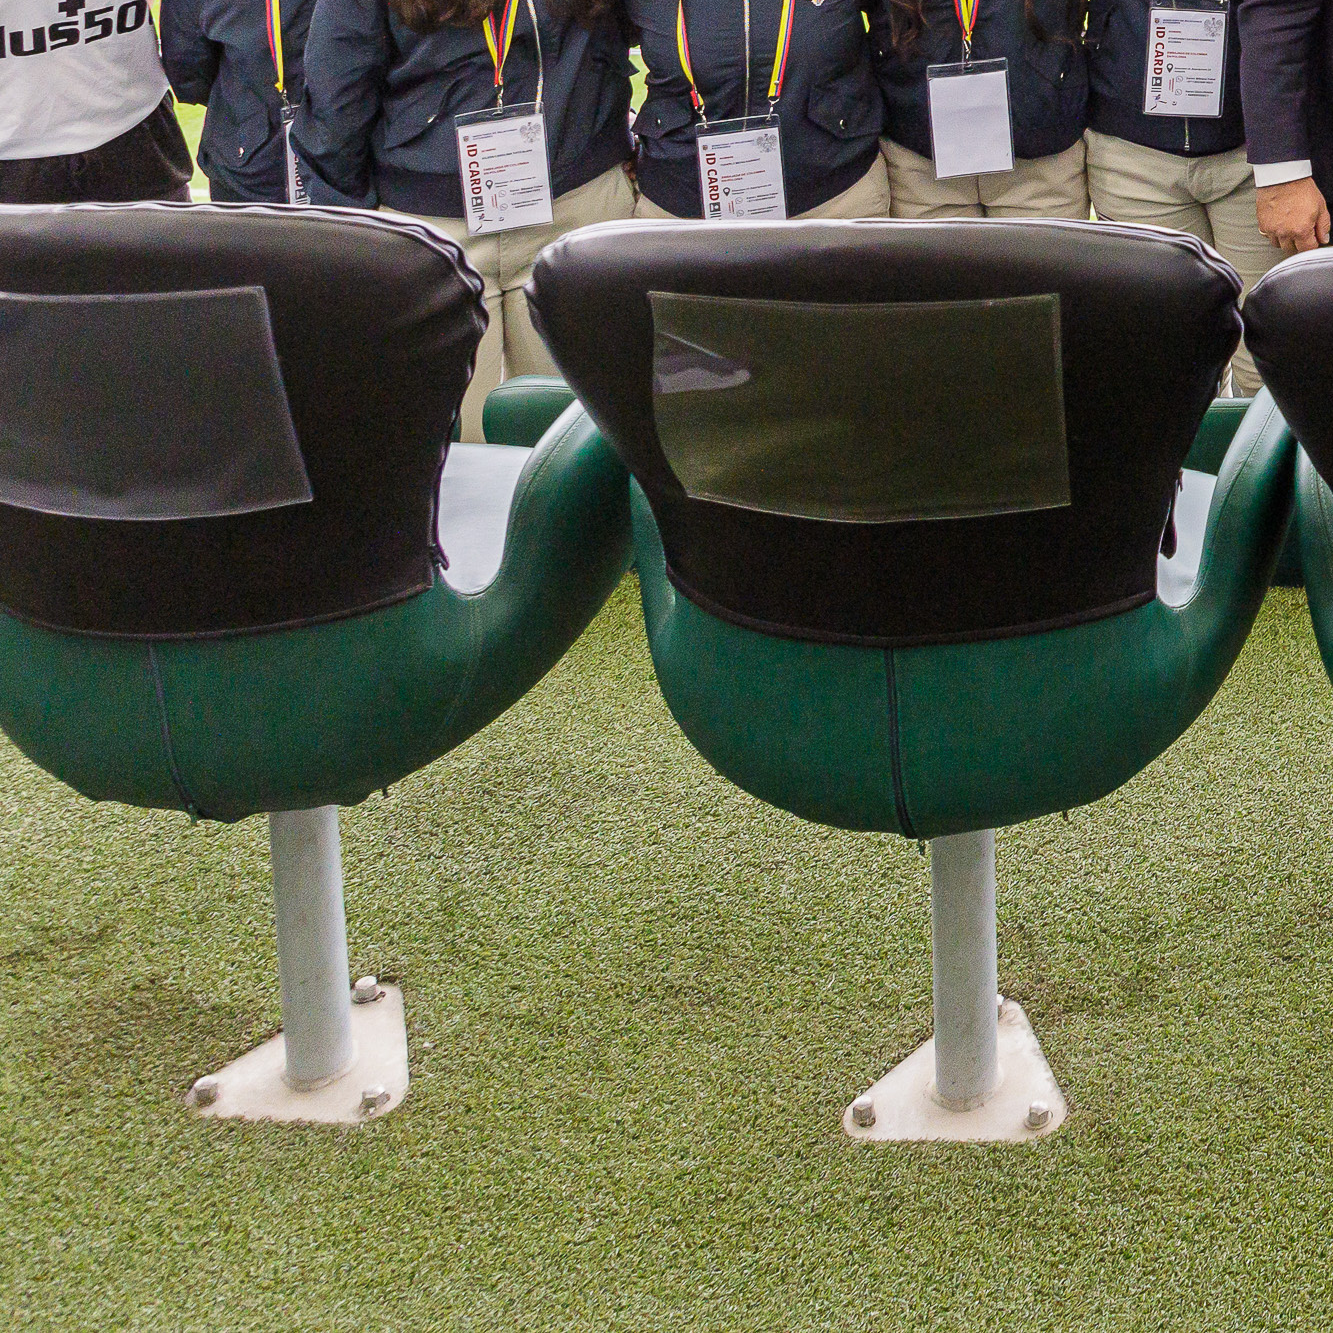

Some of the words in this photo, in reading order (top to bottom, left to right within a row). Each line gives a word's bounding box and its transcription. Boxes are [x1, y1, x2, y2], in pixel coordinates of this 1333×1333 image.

[1155, 26, 1166, 39] ID
[1153, 42, 1165, 76] CARD
[466, 144, 478, 157] ID
[705, 152, 716, 165] ID
[468, 160, 482, 195] CARD
[707, 168, 720, 201] CARD
